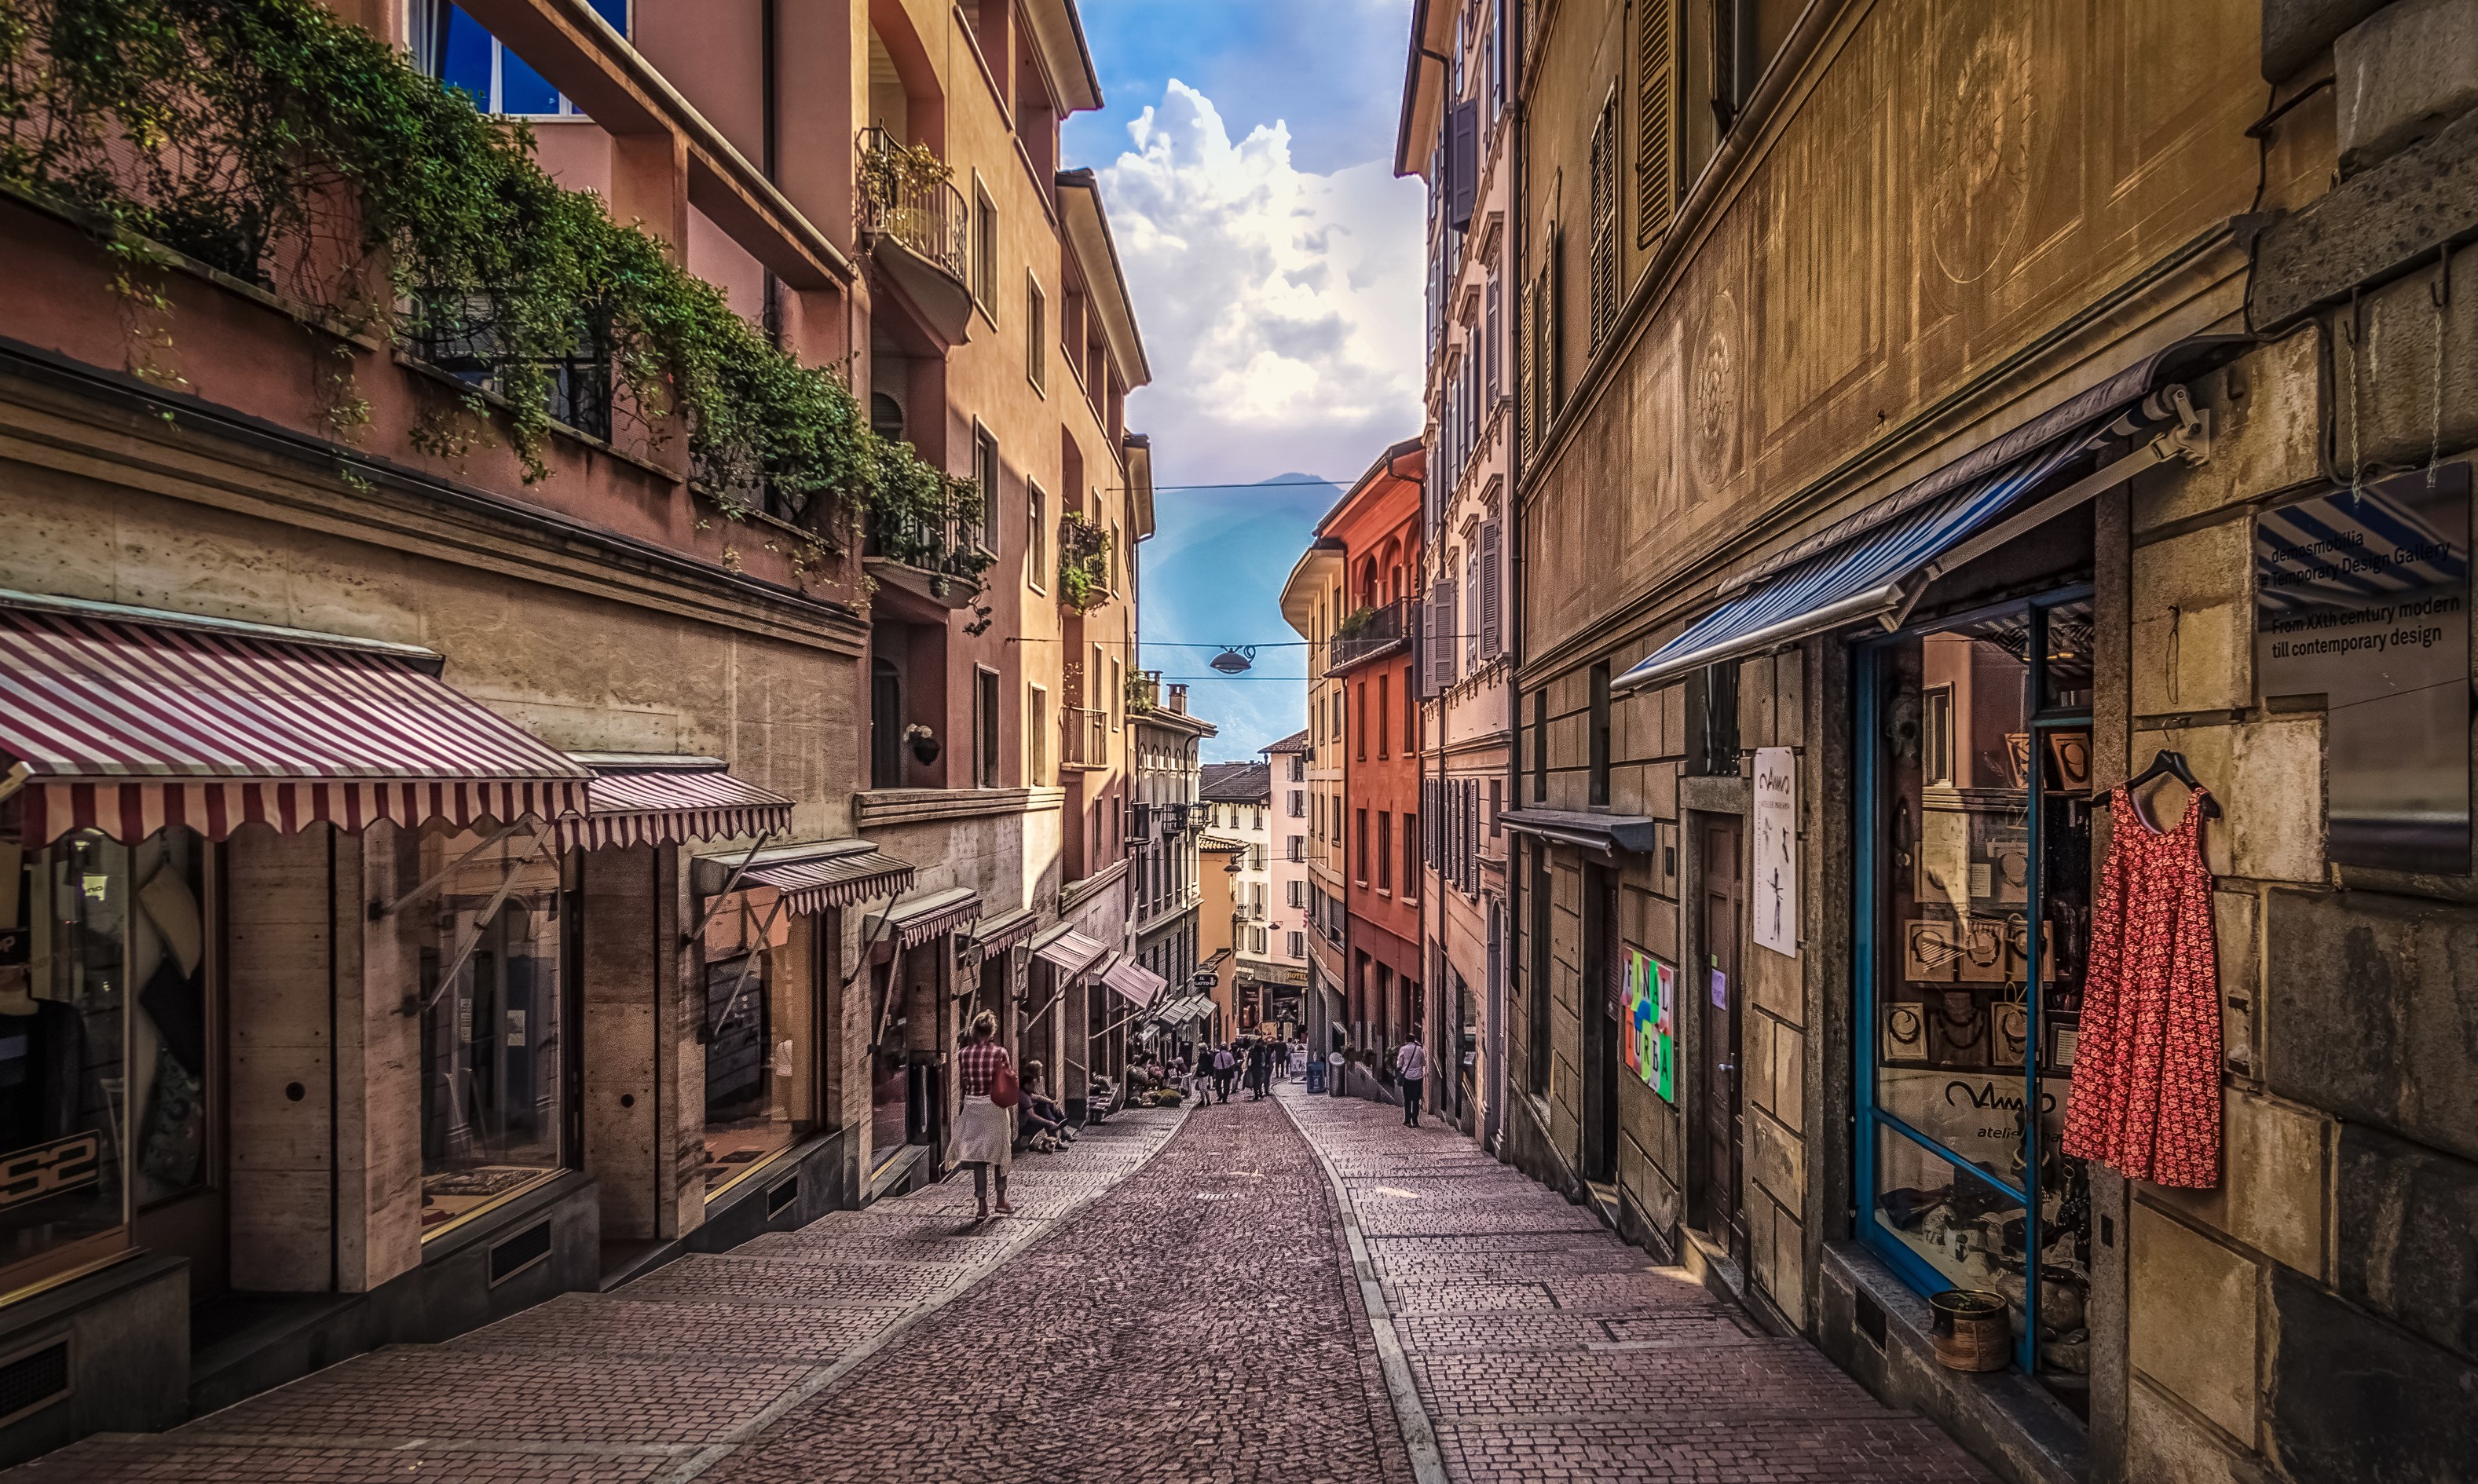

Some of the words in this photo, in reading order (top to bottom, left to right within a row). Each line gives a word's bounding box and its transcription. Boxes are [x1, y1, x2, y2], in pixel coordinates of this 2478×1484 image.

[2271, 531, 2364, 564] demosmobilia
[2271, 563, 2339, 587] Temporary
[2342, 554, 2390, 574] Design
[2395, 542, 2451, 565] Gallery
[2272, 618, 2304, 634] From
[2306, 611, 2337, 631] XXth
[2340, 605, 2395, 626] century
[2399, 597, 2460, 619] modern
[2272, 641, 2289, 659] till
[2292, 633, 2387, 656] contemporary
[2390, 625, 2442, 649] design
[1627, 959, 1668, 1012] FINAL
[1627, 1022, 1669, 1082] TURBA
[1978, 1127, 2022, 1139] atelie
